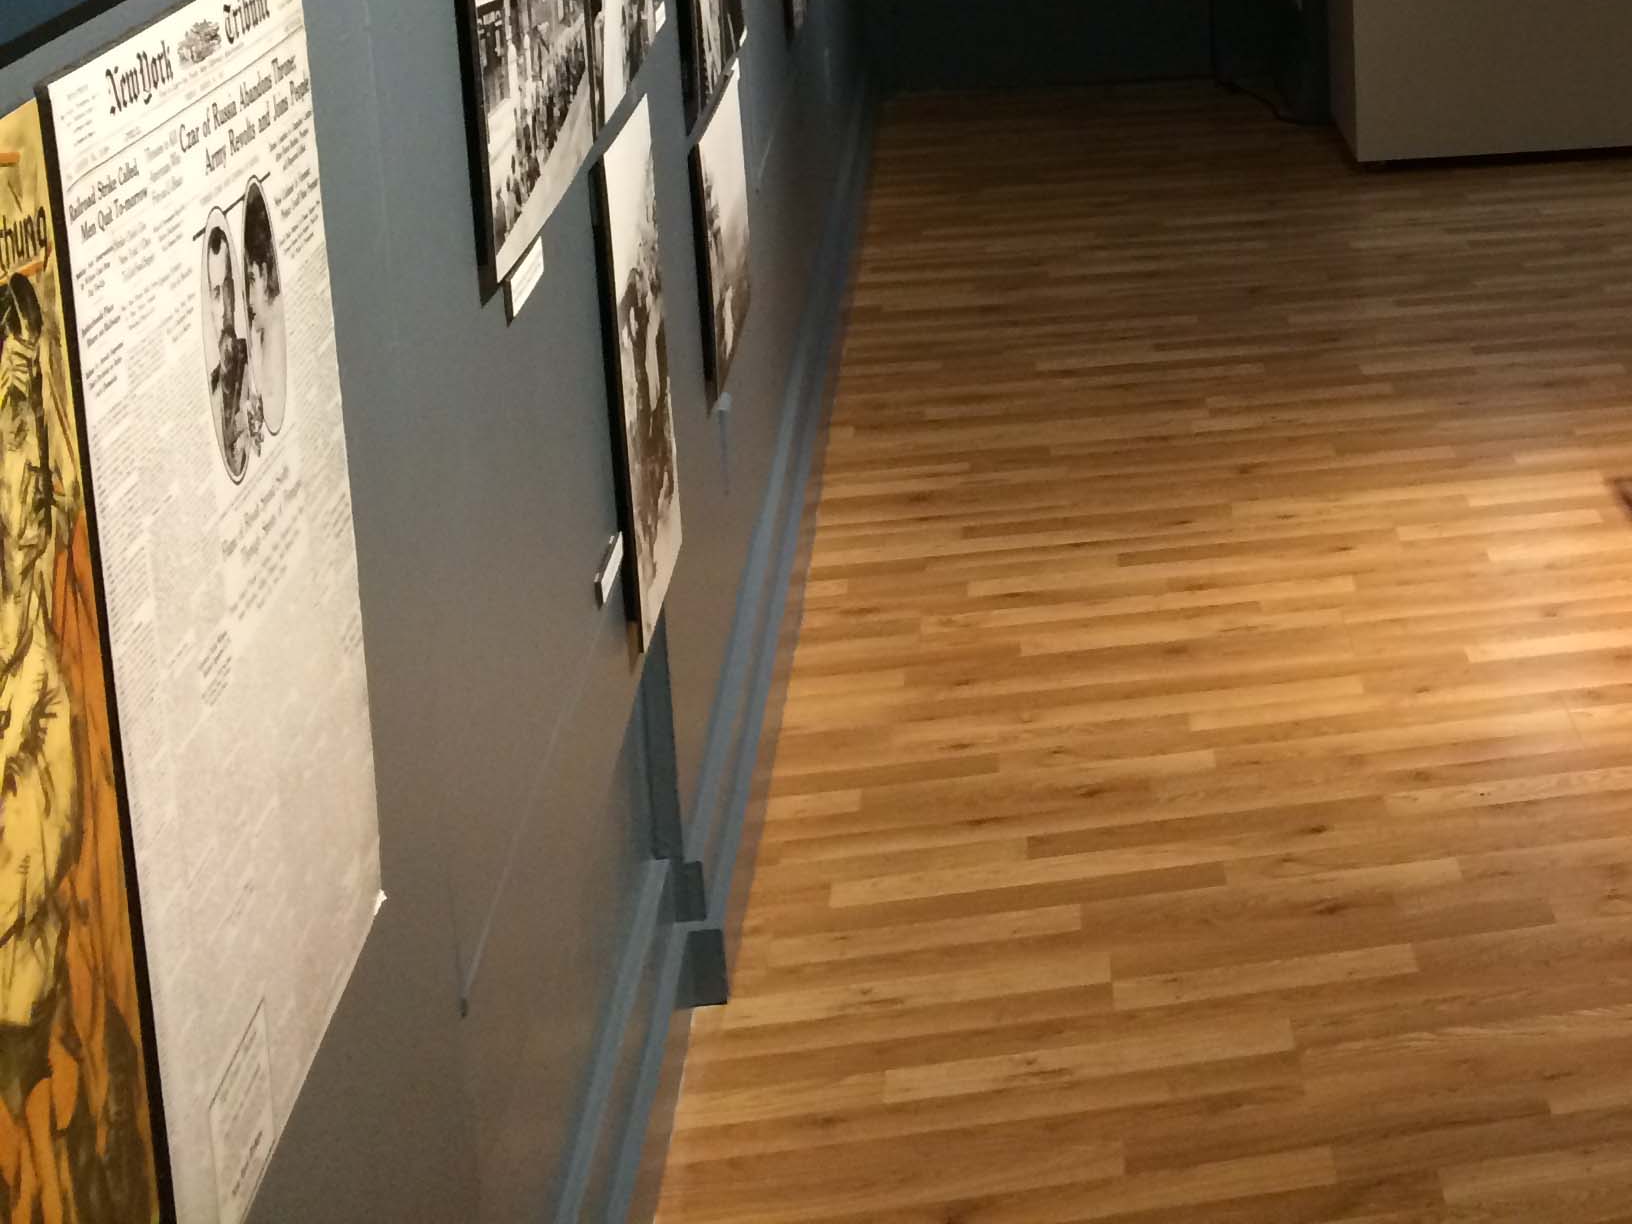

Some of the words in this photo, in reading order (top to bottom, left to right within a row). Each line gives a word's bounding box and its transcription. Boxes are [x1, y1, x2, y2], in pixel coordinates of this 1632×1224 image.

[105, 65, 140, 116] New
[179, 123, 200, 153] Czar
[202, 107, 211, 137] of
